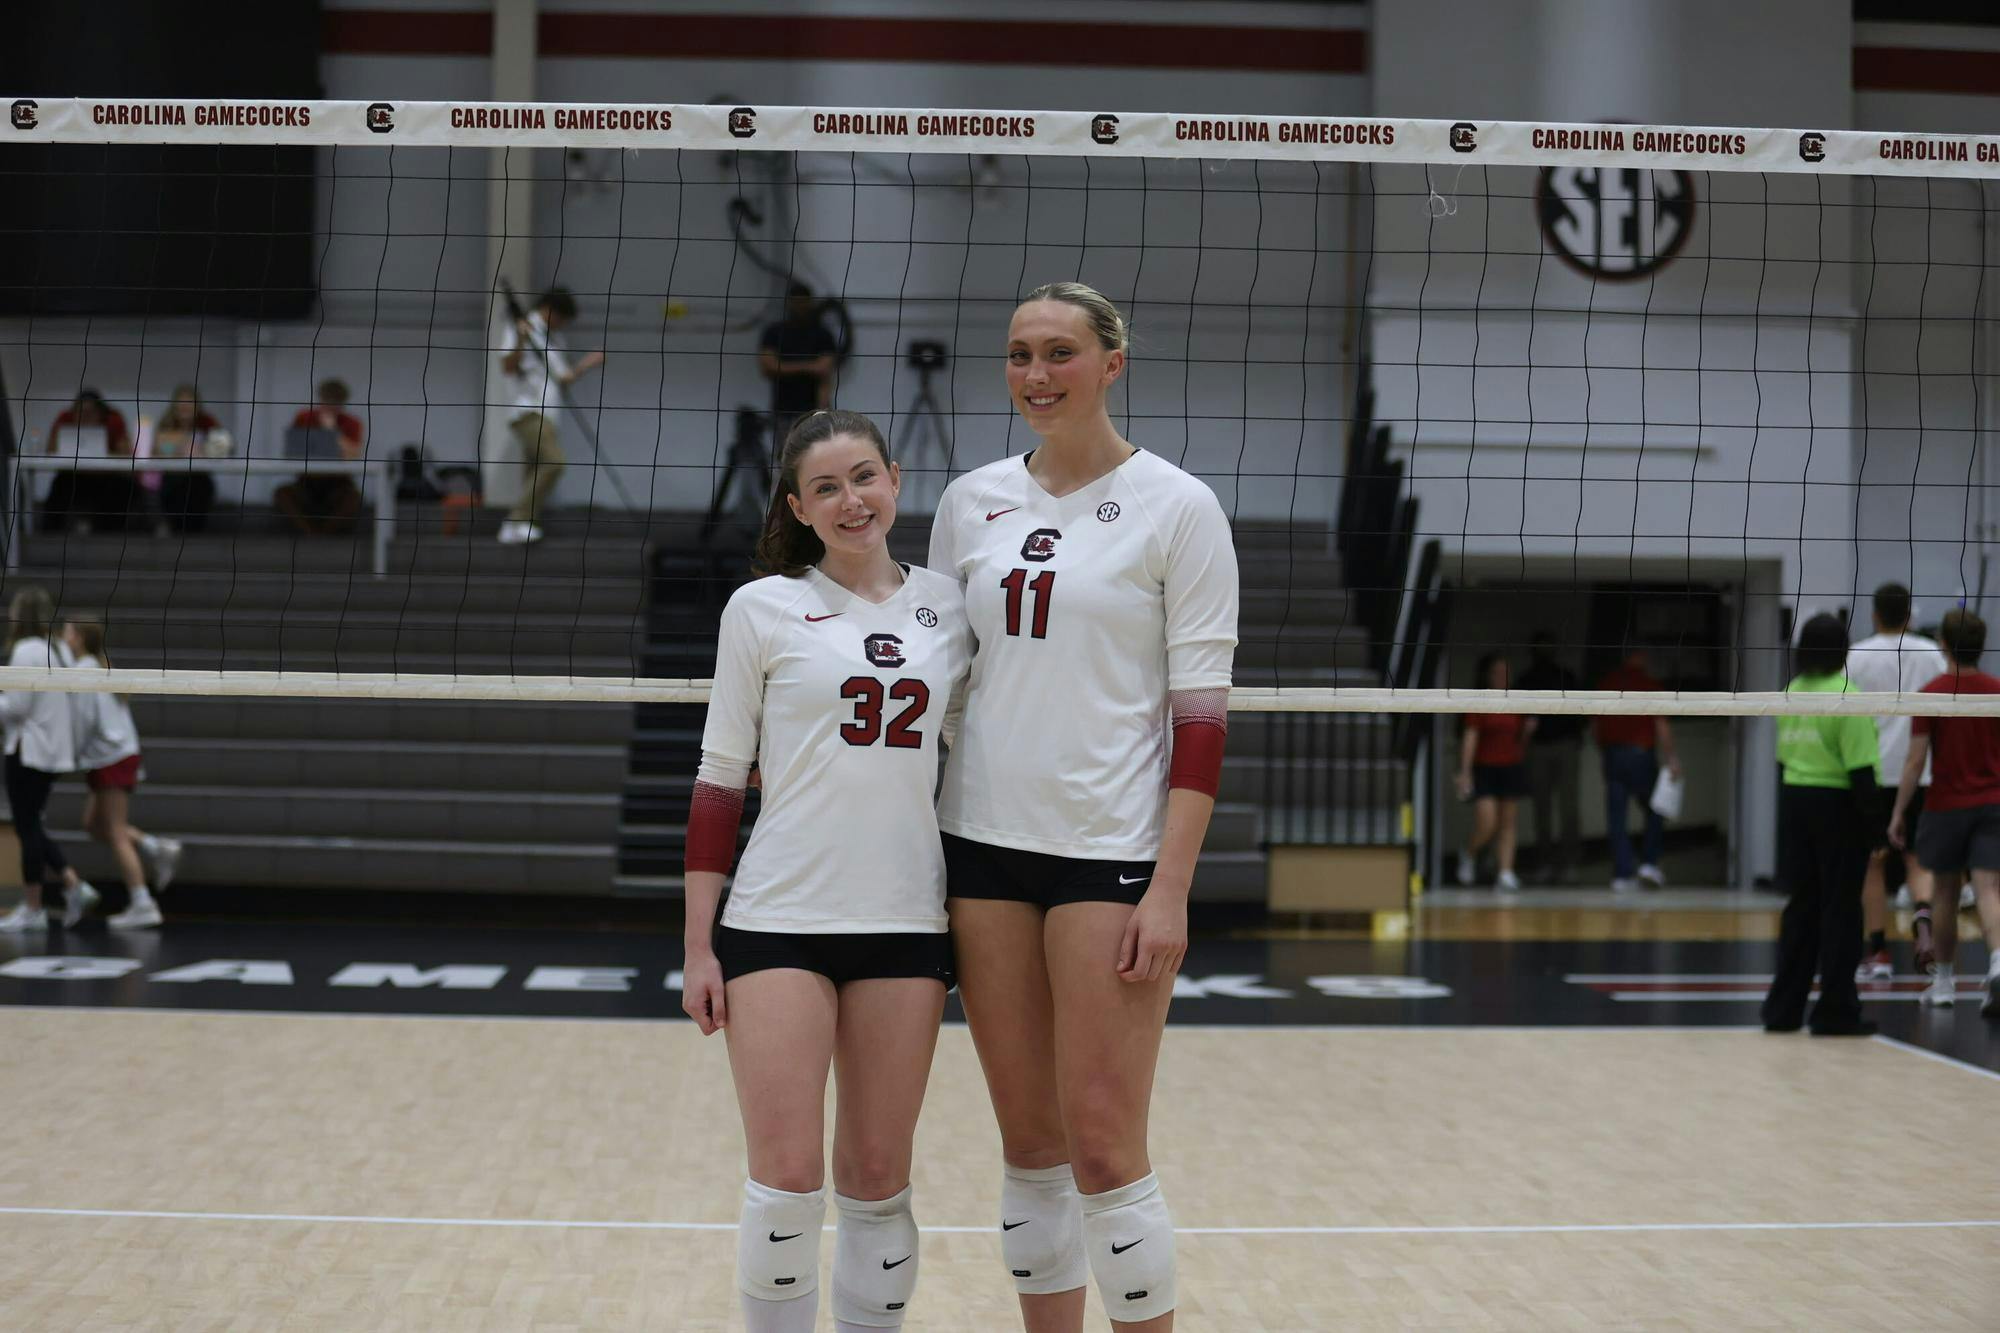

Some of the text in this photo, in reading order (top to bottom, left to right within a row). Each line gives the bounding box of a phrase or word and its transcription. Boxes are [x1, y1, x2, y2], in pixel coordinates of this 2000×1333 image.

[92, 104, 311, 127] CAROLINA GAMECOCKS
[451, 108, 672, 131] CAROLINA GAMECOCKS
[813, 113, 1035, 138] CAROLINA GAMECOCKS
[1175, 120, 1394, 146] CAROLINA GAMECOCKS
[1532, 128, 1746, 155] CAROLINA GAMECOCKS
[1879, 139, 1969, 162] CAROLINA
[1550, 167, 1682, 272] SEC
[1099, 503, 1119, 521] SEC
[1000, 568, 1056, 639] 11
[917, 609, 937, 627] SEC
[840, 676, 930, 749] 32
